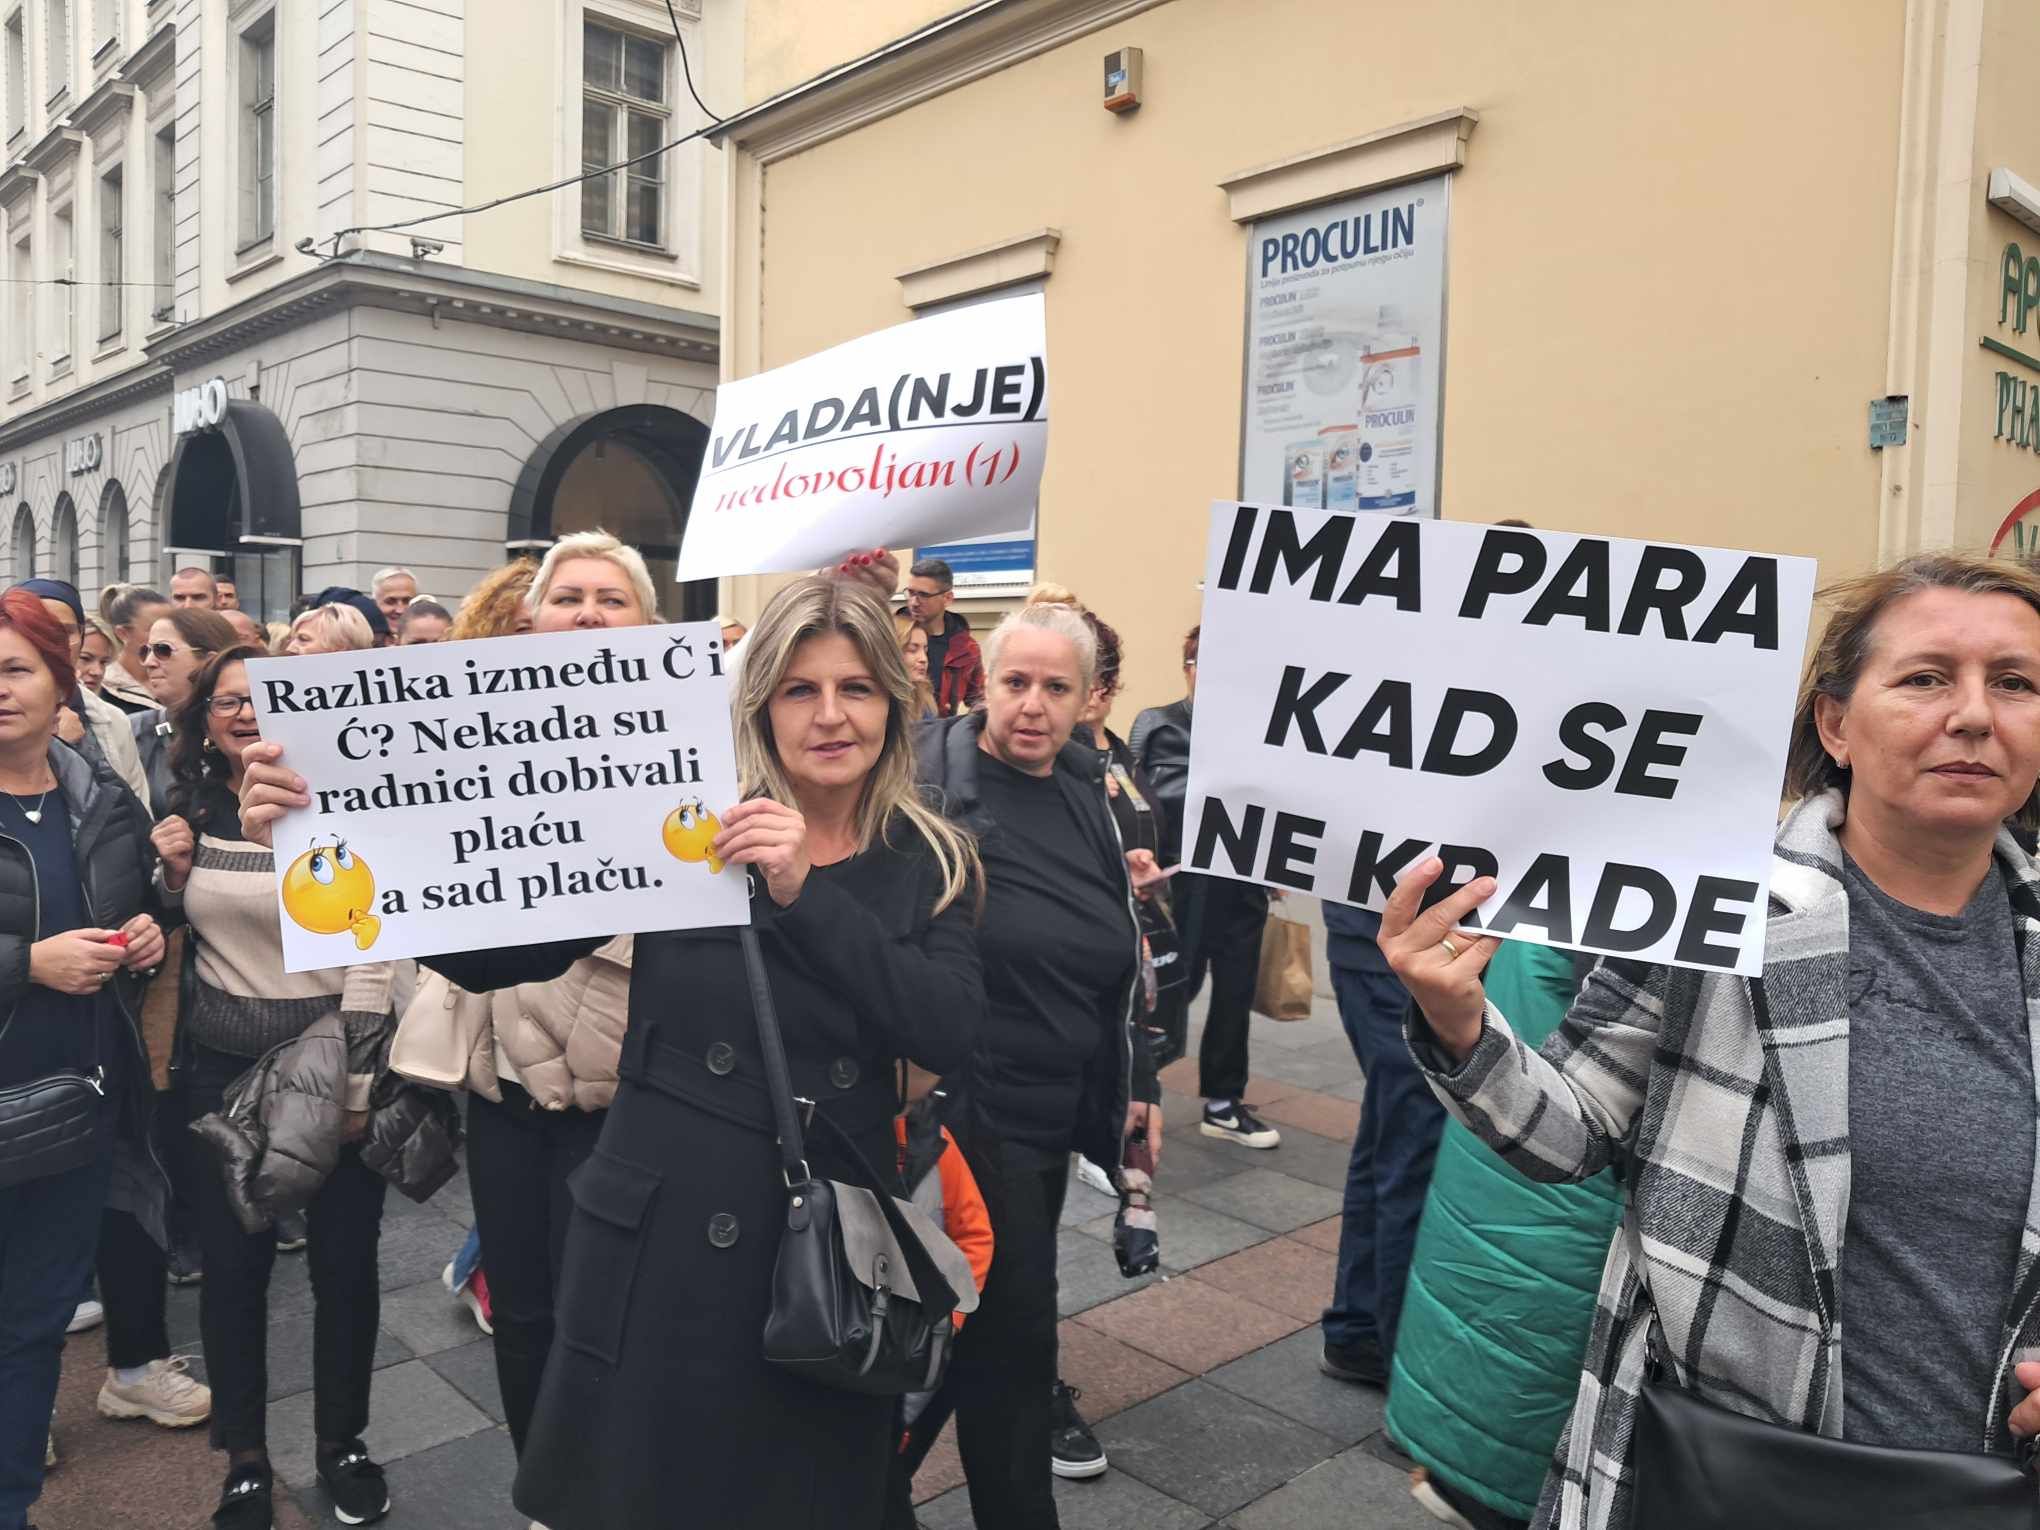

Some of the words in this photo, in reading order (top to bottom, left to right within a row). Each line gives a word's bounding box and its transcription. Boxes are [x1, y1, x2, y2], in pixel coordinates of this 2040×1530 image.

[1999, 242, 2040, 334] AP
[711, 355, 1046, 469] VLADA(NJE)
[1364, 409, 1415, 429] PROCULIN
[1217, 506, 1422, 613] IMA
[1457, 529, 1780, 651] PARA
[262, 666, 451, 715] Razlika
[466, 648, 651, 697] između
[662, 636, 696, 680] Č
[709, 640, 725, 677] i
[336, 716, 395, 761] Ć?
[410, 704, 598, 754] Nekada
[613, 709, 668, 736] su
[1263, 665, 1518, 777] KAD
[1542, 701, 1704, 800] SE
[315, 764, 496, 815] radnici
[508, 747, 703, 798] dobivali
[450, 811, 584, 865] plaću
[1190, 796, 1327, 892] NE
[381, 889, 408, 916] a
[421, 868, 506, 911] sad
[517, 856, 665, 911] plaču.
